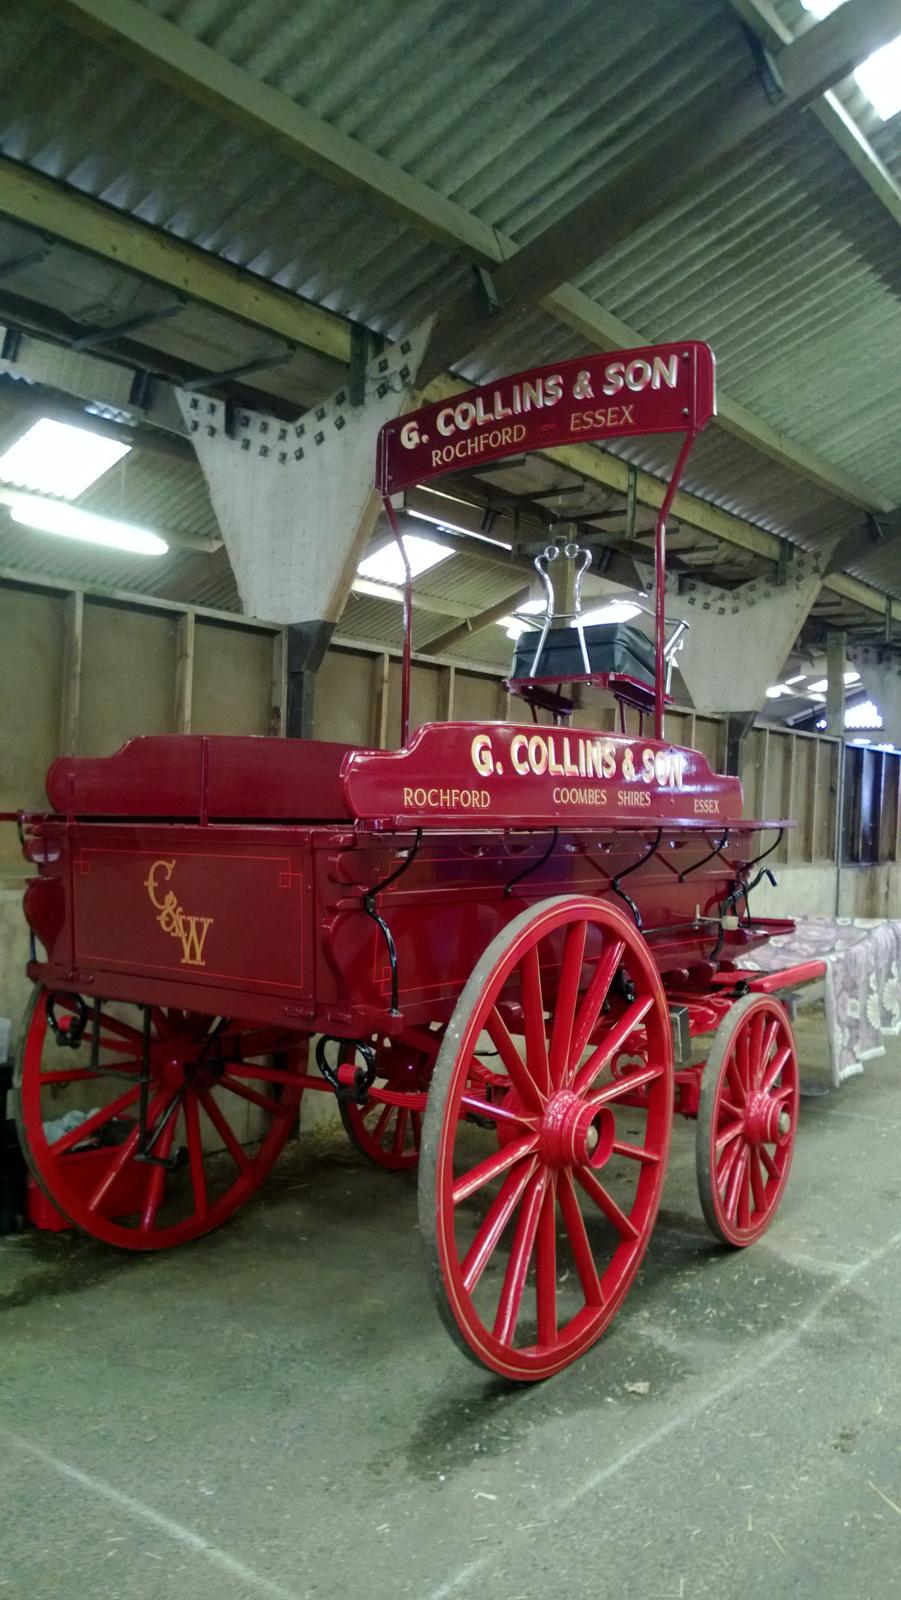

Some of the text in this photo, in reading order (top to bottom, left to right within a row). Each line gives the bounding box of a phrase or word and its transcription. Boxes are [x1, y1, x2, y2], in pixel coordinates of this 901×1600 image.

[400, 354, 679, 449] G. COLLINS & SON
[431, 404, 636, 467] ROCHFORD ESSEX
[471, 734, 685, 788] G. COLLINS & SON
[403, 787, 720, 814] ROCHFORD COOMBES SHIRES ESSEX
